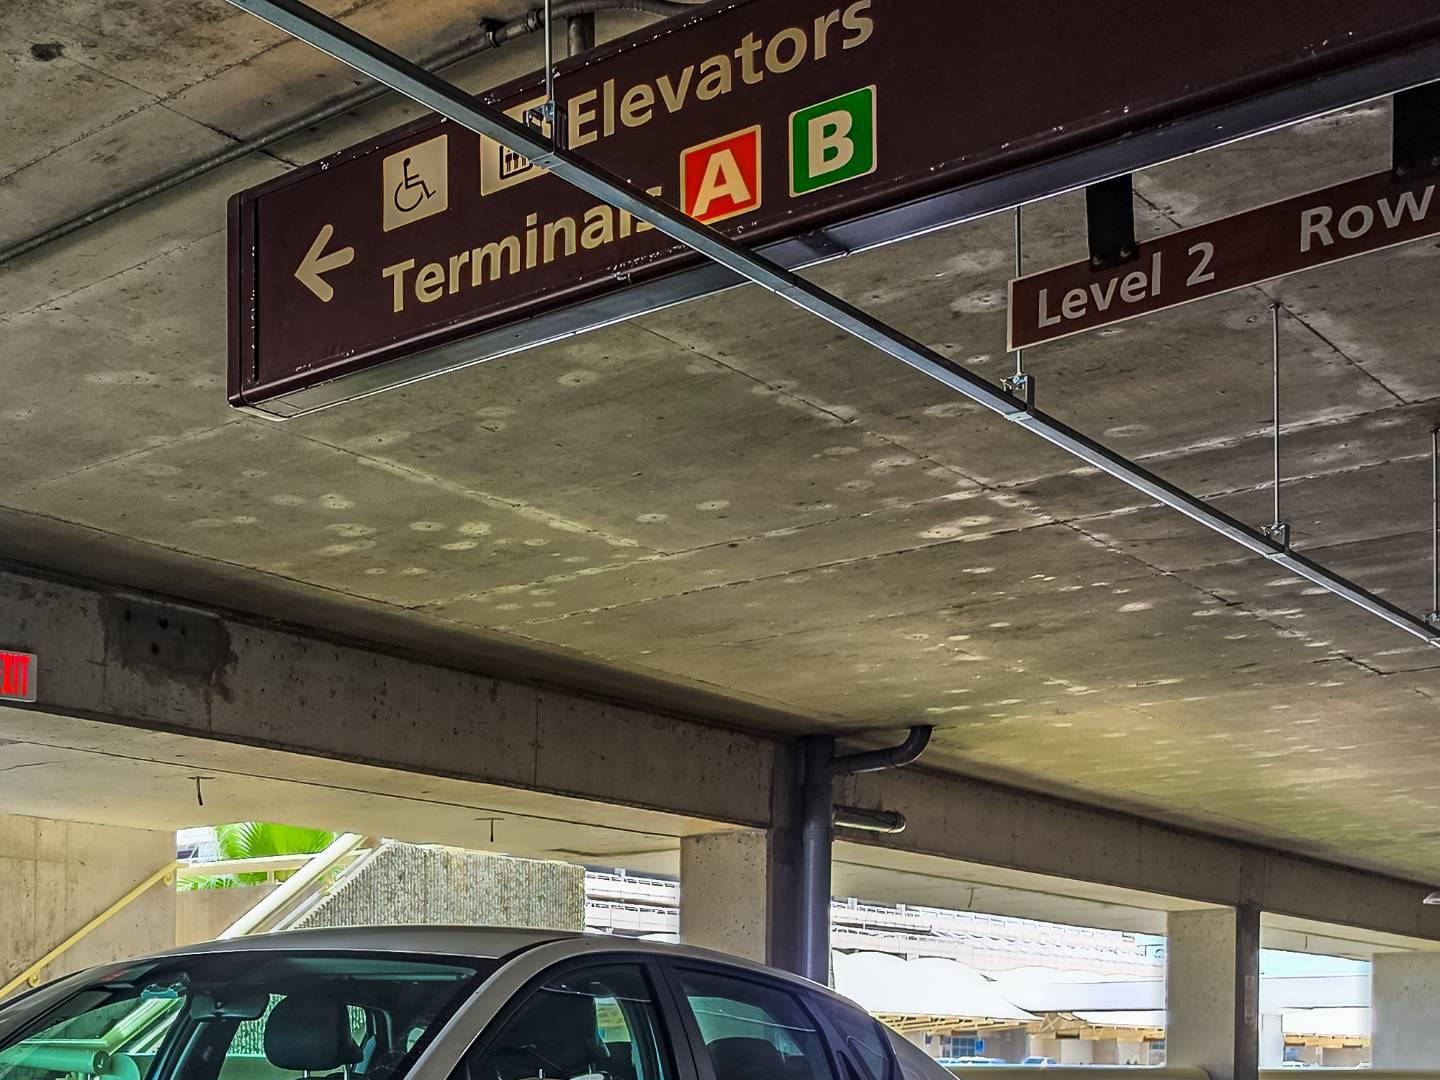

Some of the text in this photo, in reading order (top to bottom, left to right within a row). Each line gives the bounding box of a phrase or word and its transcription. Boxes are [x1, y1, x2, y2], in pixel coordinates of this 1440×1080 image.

[568, 0, 874, 150] Elevators
[691, 148, 750, 218] A
[807, 109, 855, 180] B
[1037, 184, 1436, 328] Level 2 Row
